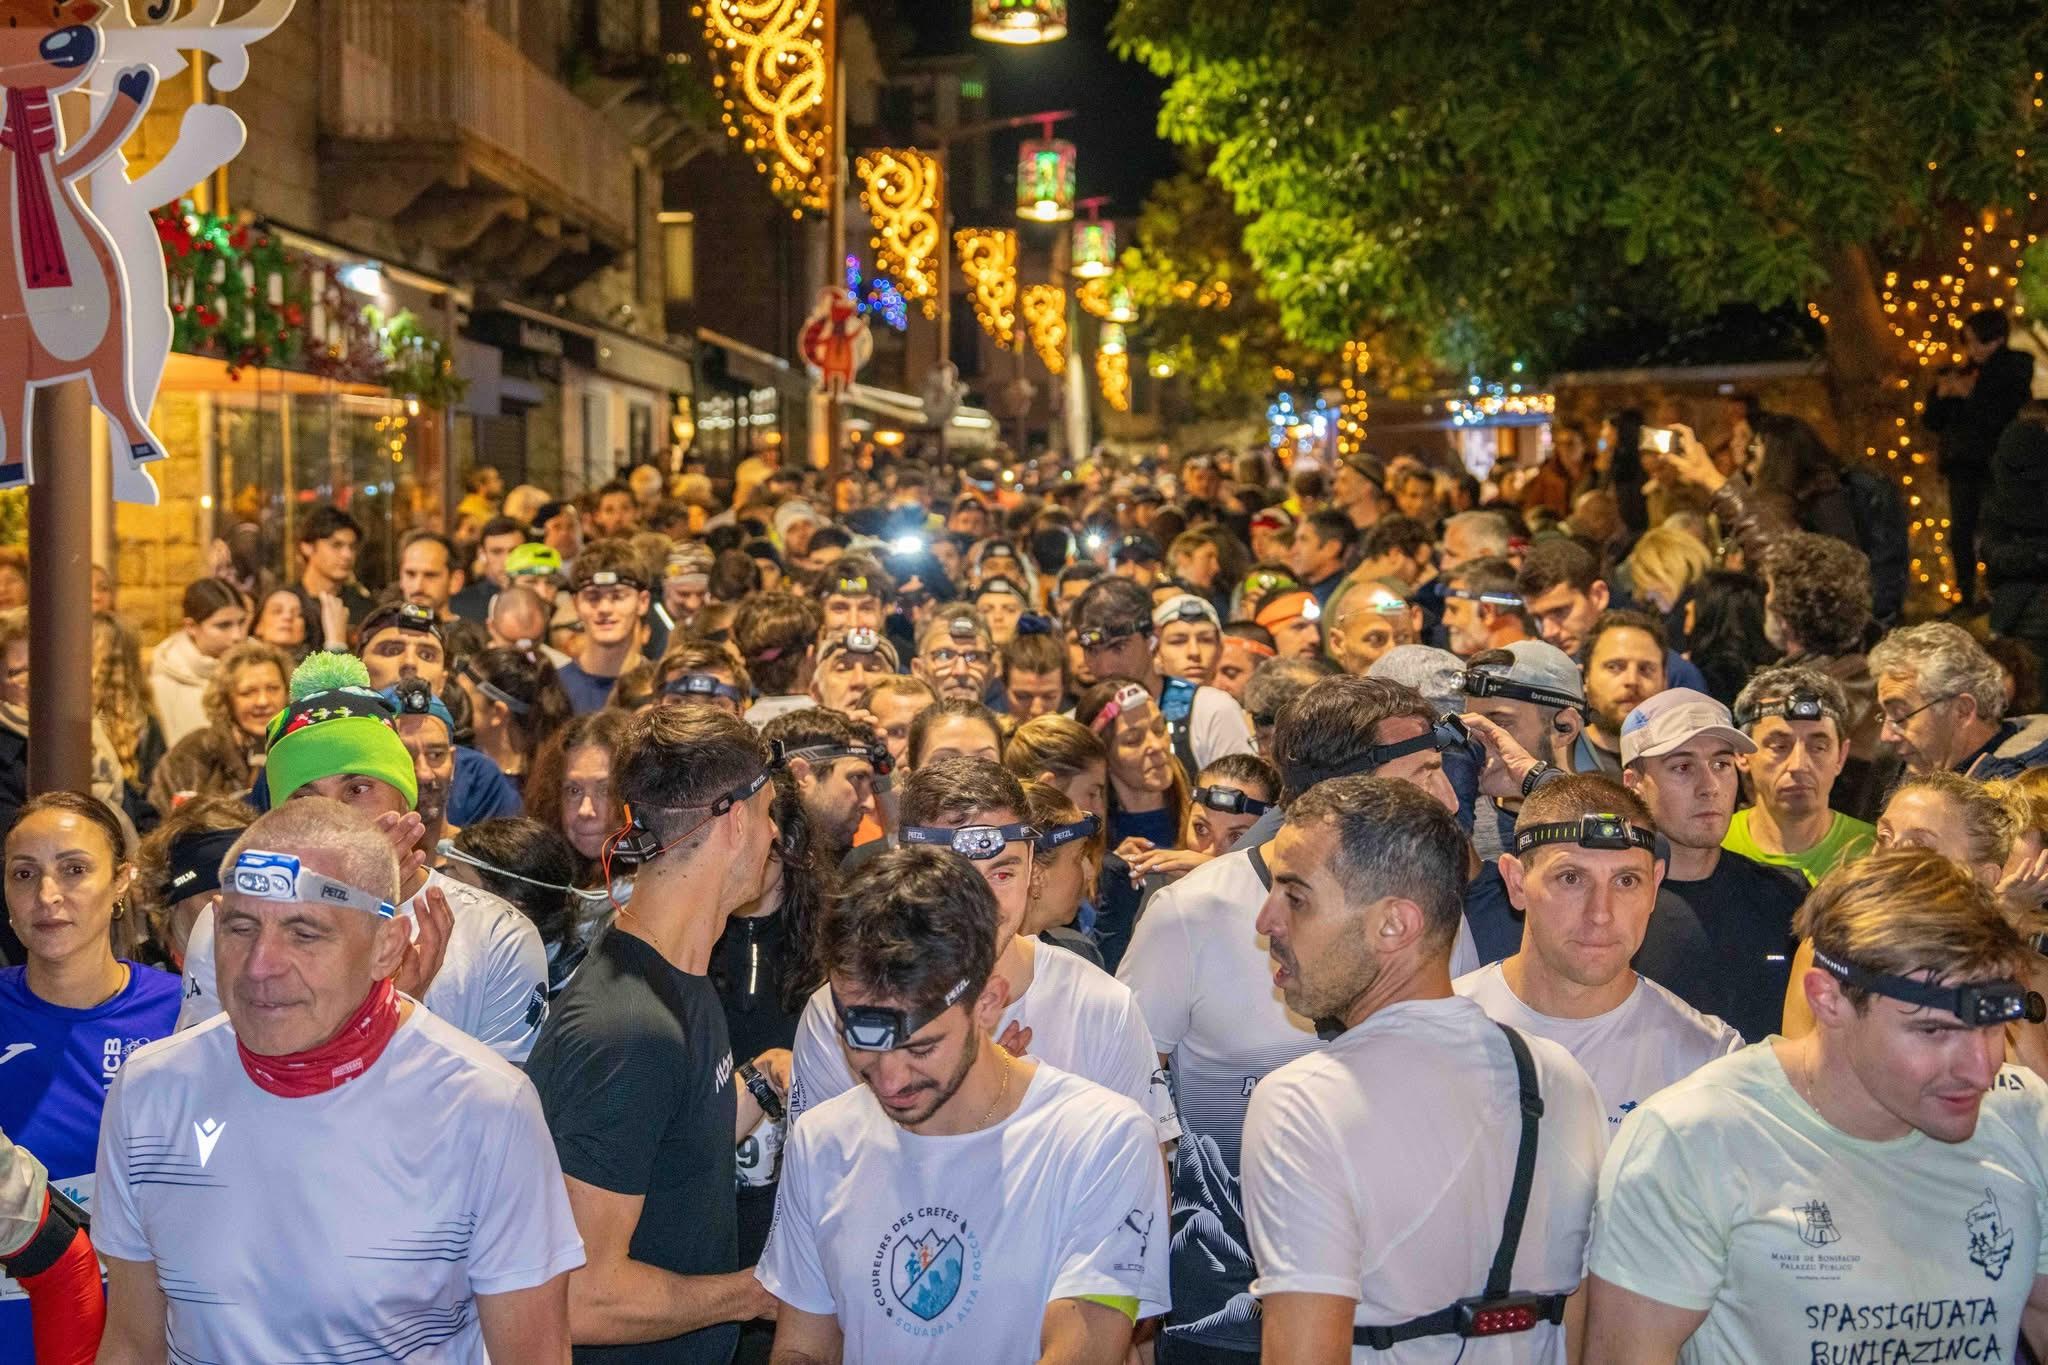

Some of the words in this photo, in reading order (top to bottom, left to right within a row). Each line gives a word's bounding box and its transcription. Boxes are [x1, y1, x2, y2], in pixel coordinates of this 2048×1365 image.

[908, 831, 926, 840] PETZL
[1053, 830, 1074, 844] PETZL
[174, 870, 198, 888] SILVA
[321, 884, 350, 902] PETZL
[943, 979, 970, 1006] PETZL
[872, 1234, 892, 1307] COUREURS
[892, 1212, 915, 1233] DES
[918, 1207, 960, 1224] CRETES
[967, 1230, 983, 1281] ROCCA
[957, 1288, 979, 1322] ALTA
[895, 1316, 954, 1337] SQUADRA
[1811, 1333, 2001, 1365] BUNIFAZINCA
